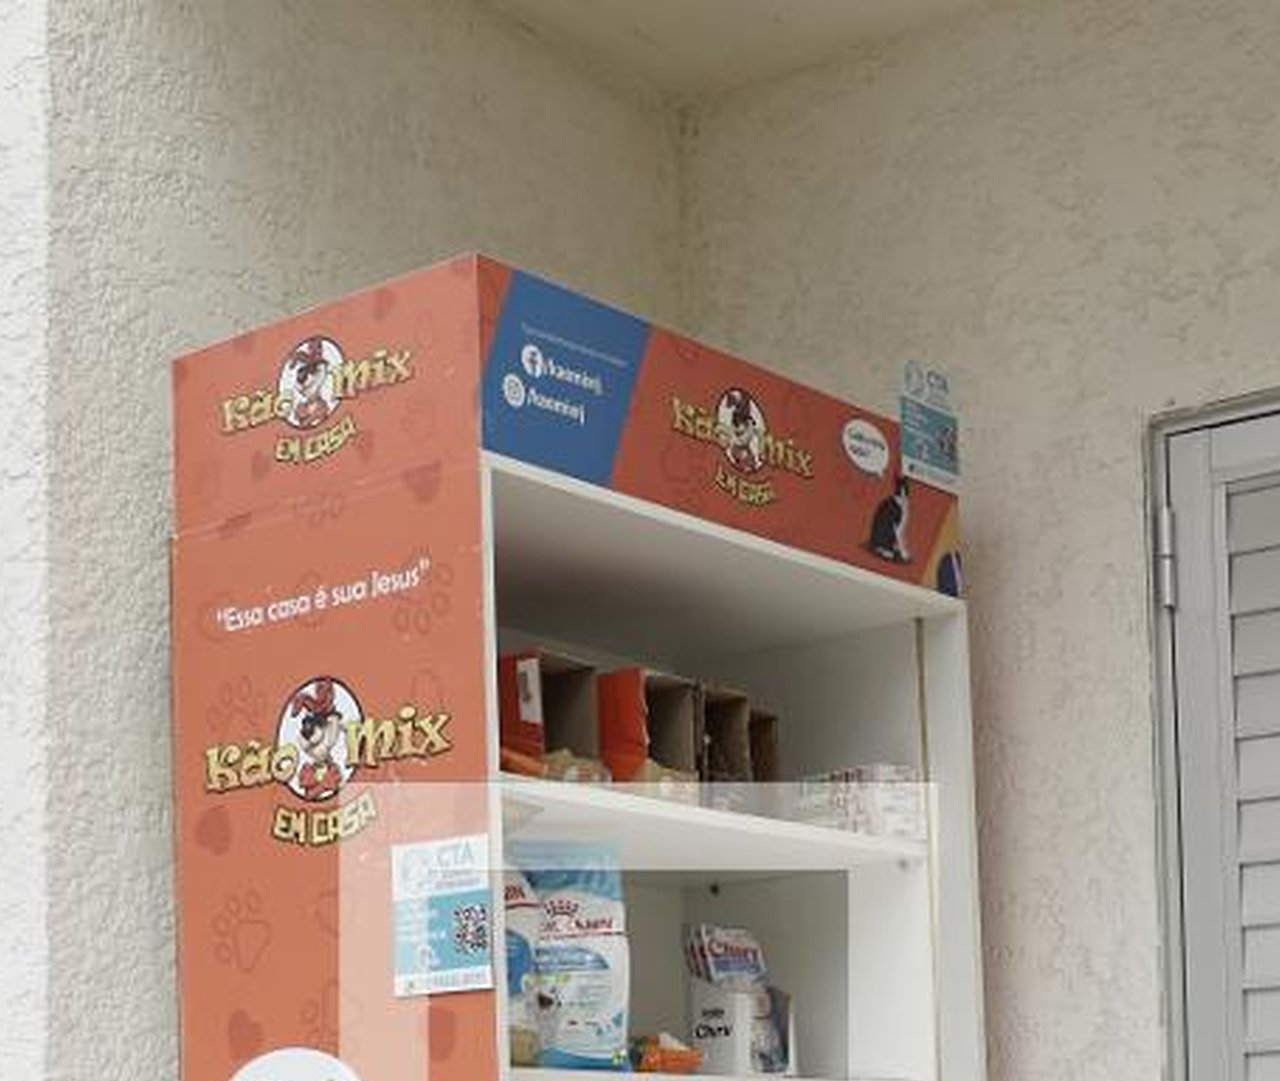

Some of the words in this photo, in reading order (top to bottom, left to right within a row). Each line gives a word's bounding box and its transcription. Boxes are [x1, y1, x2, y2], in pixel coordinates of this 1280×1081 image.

[221, 391, 294, 434] Kão
[303, 416, 358, 463] CASA
[268, 595, 311, 620] casa
[314, 584, 327, 609] é
[331, 582, 368, 608] sua
[205, 739, 299, 794] Kão
[272, 804, 306, 845] EM
[309, 790, 377, 846] CASA
